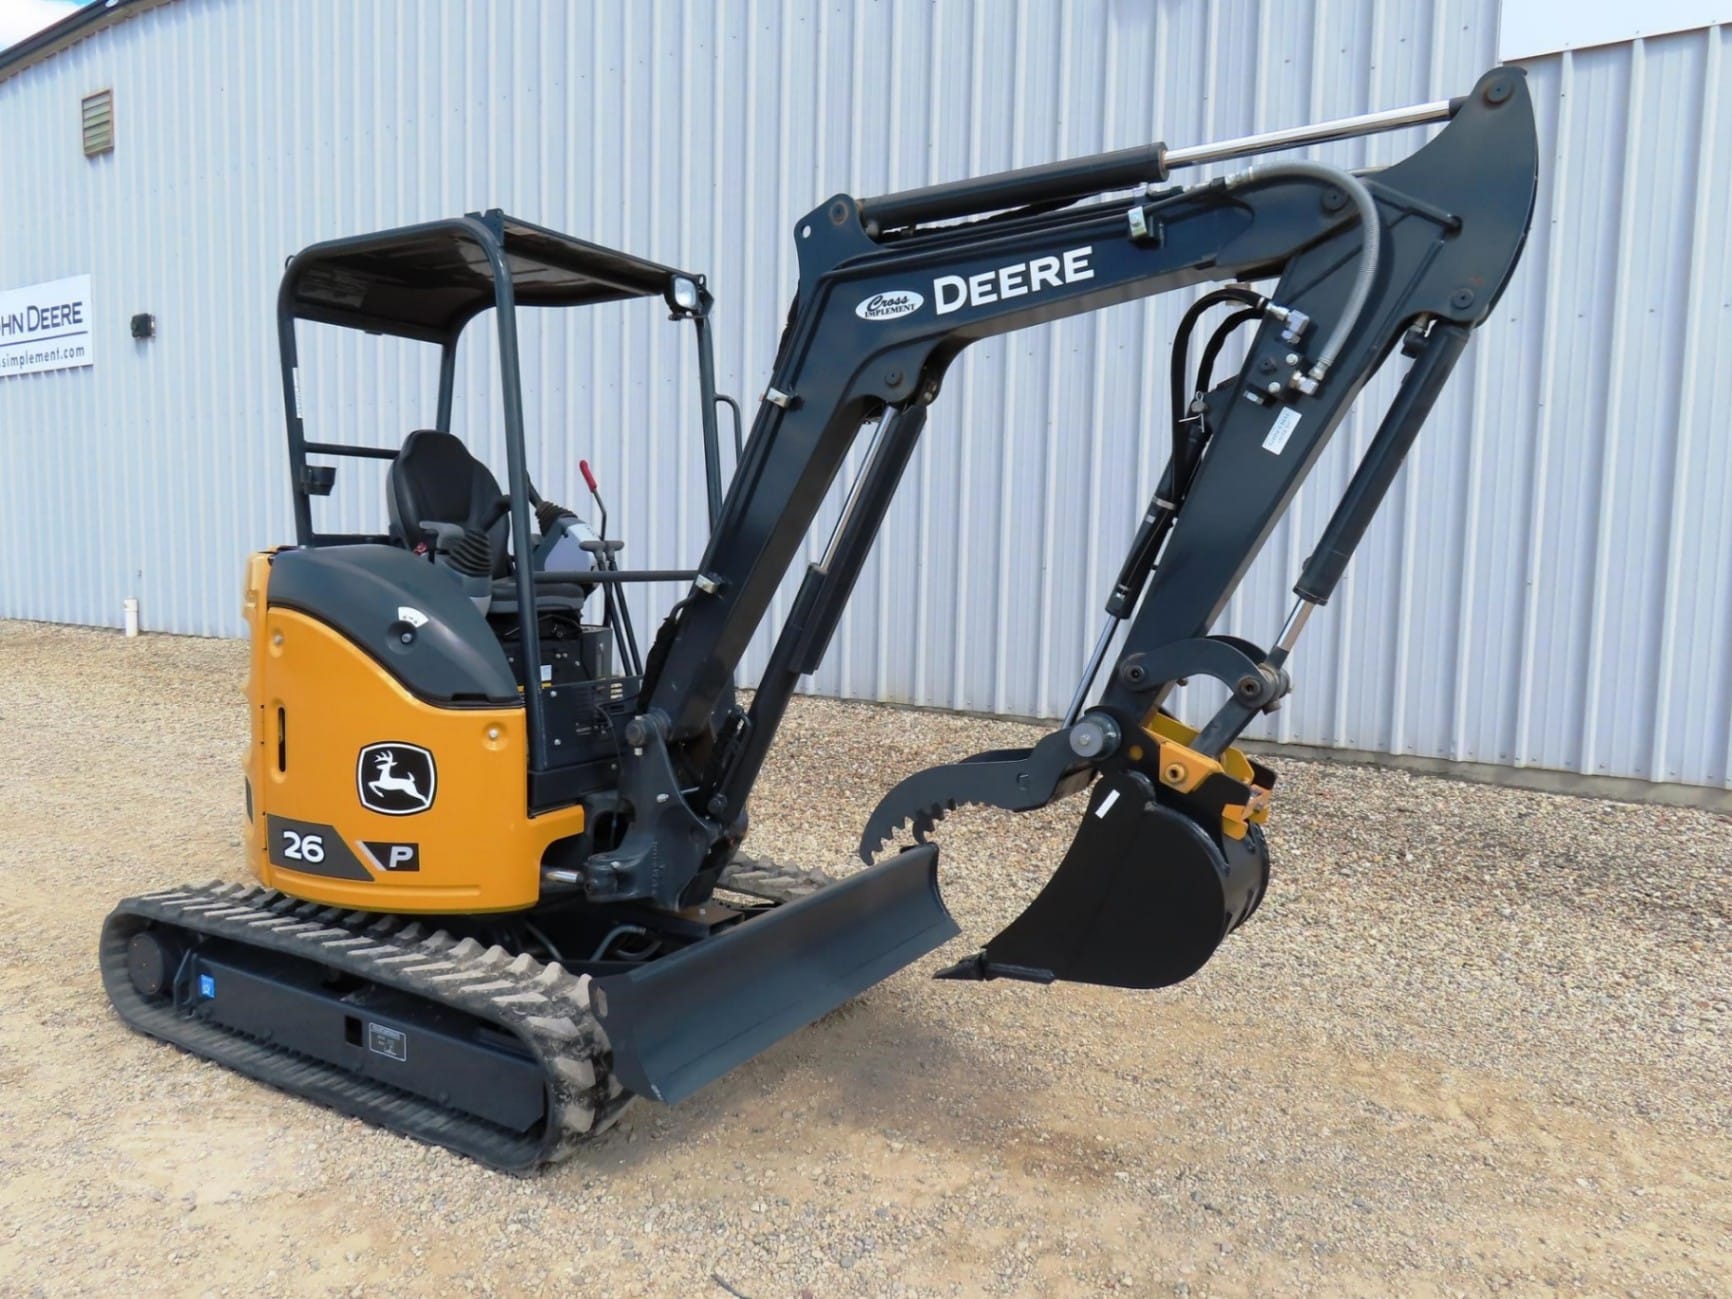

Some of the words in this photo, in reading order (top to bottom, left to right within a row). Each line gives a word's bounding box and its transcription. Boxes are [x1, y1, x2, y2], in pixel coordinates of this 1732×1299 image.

[933, 245, 1095, 315] DEERE
[865, 303, 915, 318] IMPLEMENT
[867, 294, 909, 311] Cross
[0, 312, 24, 336] HN
[27, 300, 83, 332] DEERE
[0, 346, 85, 368] simplement.com
[283, 830, 325, 864] 26
[388, 845, 414, 868] P
